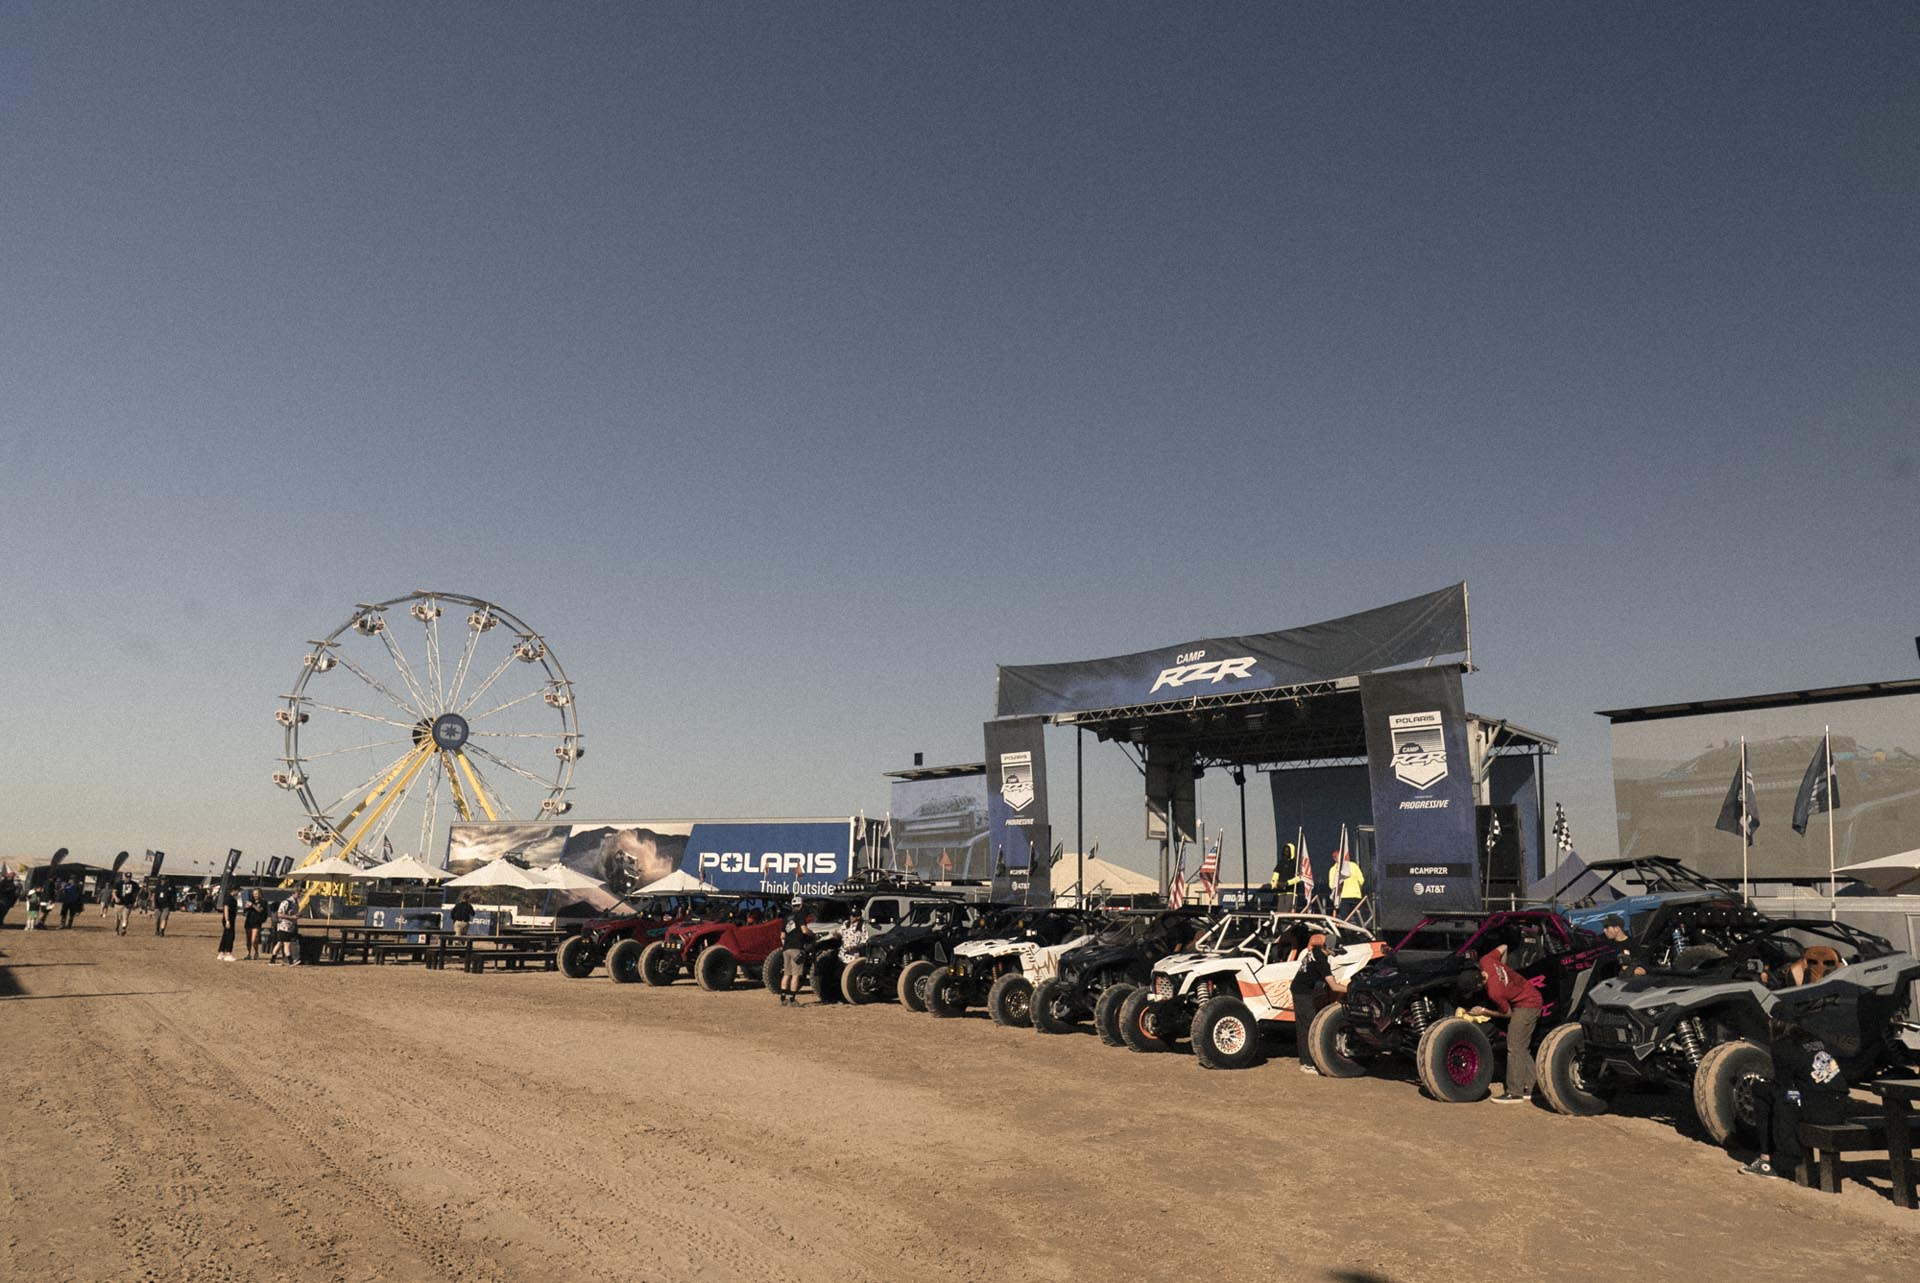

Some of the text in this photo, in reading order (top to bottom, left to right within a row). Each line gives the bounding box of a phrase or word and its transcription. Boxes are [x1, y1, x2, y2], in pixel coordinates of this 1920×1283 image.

[1176, 650, 1206, 665] CAMP
[1150, 656, 1258, 694] RZR
[1395, 715, 1435, 724] POLARIS
[1390, 750, 1447, 768] RZR
[1399, 799, 1449, 809] PROGRESSIVE
[698, 852, 837, 874] POLARIS
[1409, 867, 1448, 875] #CAMPRZR
[760, 880, 835, 896] Think Outside
[1425, 884, 1446, 894] AT&T
